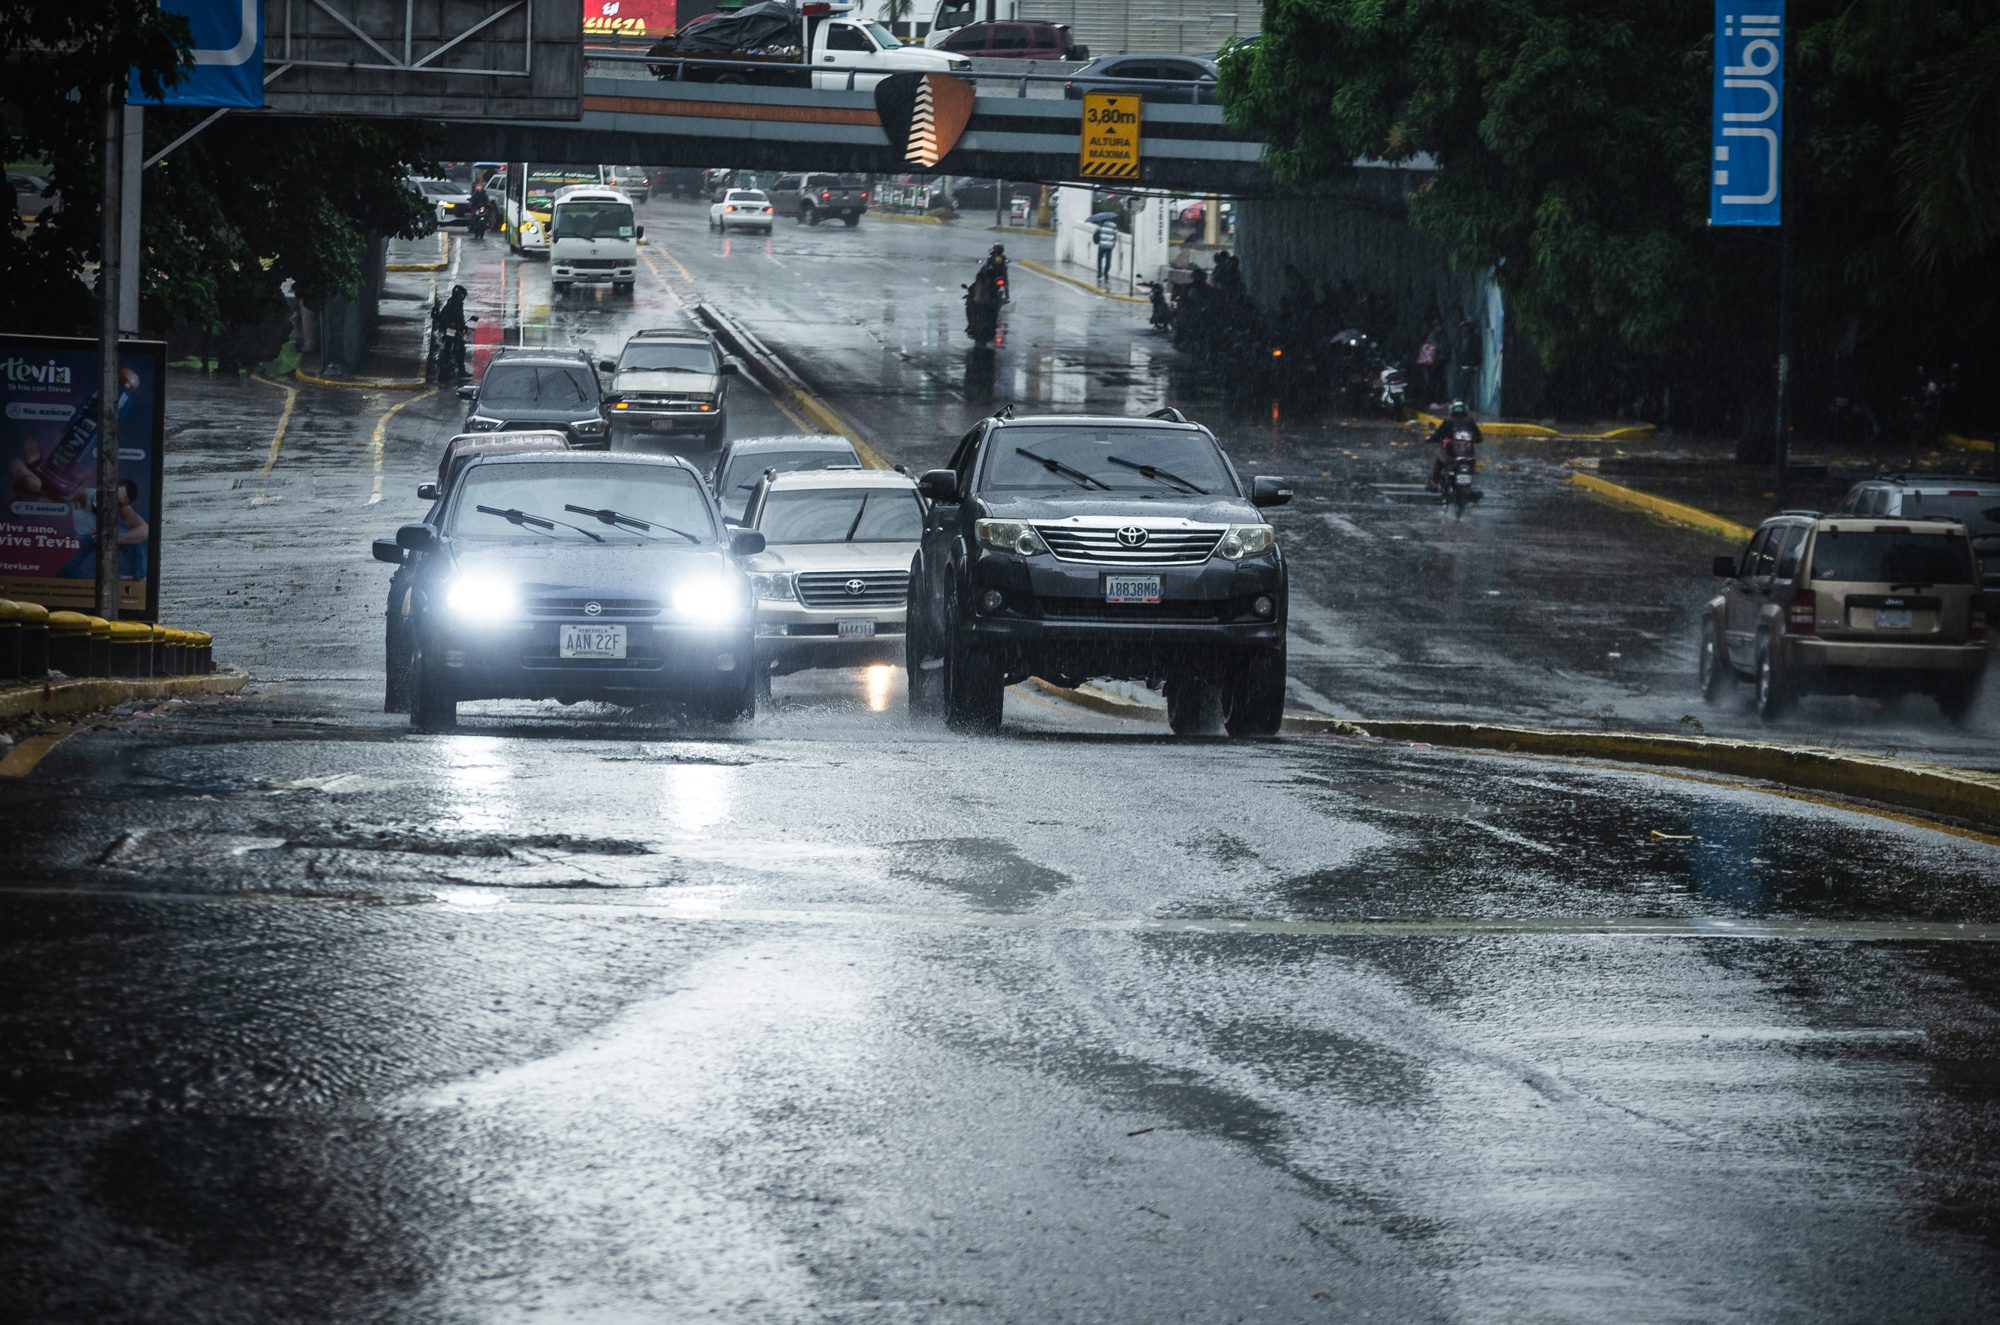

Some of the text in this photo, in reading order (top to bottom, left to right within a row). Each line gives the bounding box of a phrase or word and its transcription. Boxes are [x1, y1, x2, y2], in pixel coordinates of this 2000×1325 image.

[1087, 108, 1136, 125] 3,80m
[1089, 137, 1131, 147] ALTURA
[1088, 148, 1131, 159] MÁXIMA
[48, 385, 71, 393] Stevia
[39, 408, 72, 416] azúcar
[0, 522, 58, 535] Vive sano,
[35, 535, 81, 549] Tevia
[1109, 582, 1158, 597] AB838MB
[566, 633, 621, 650] AAN 22F
